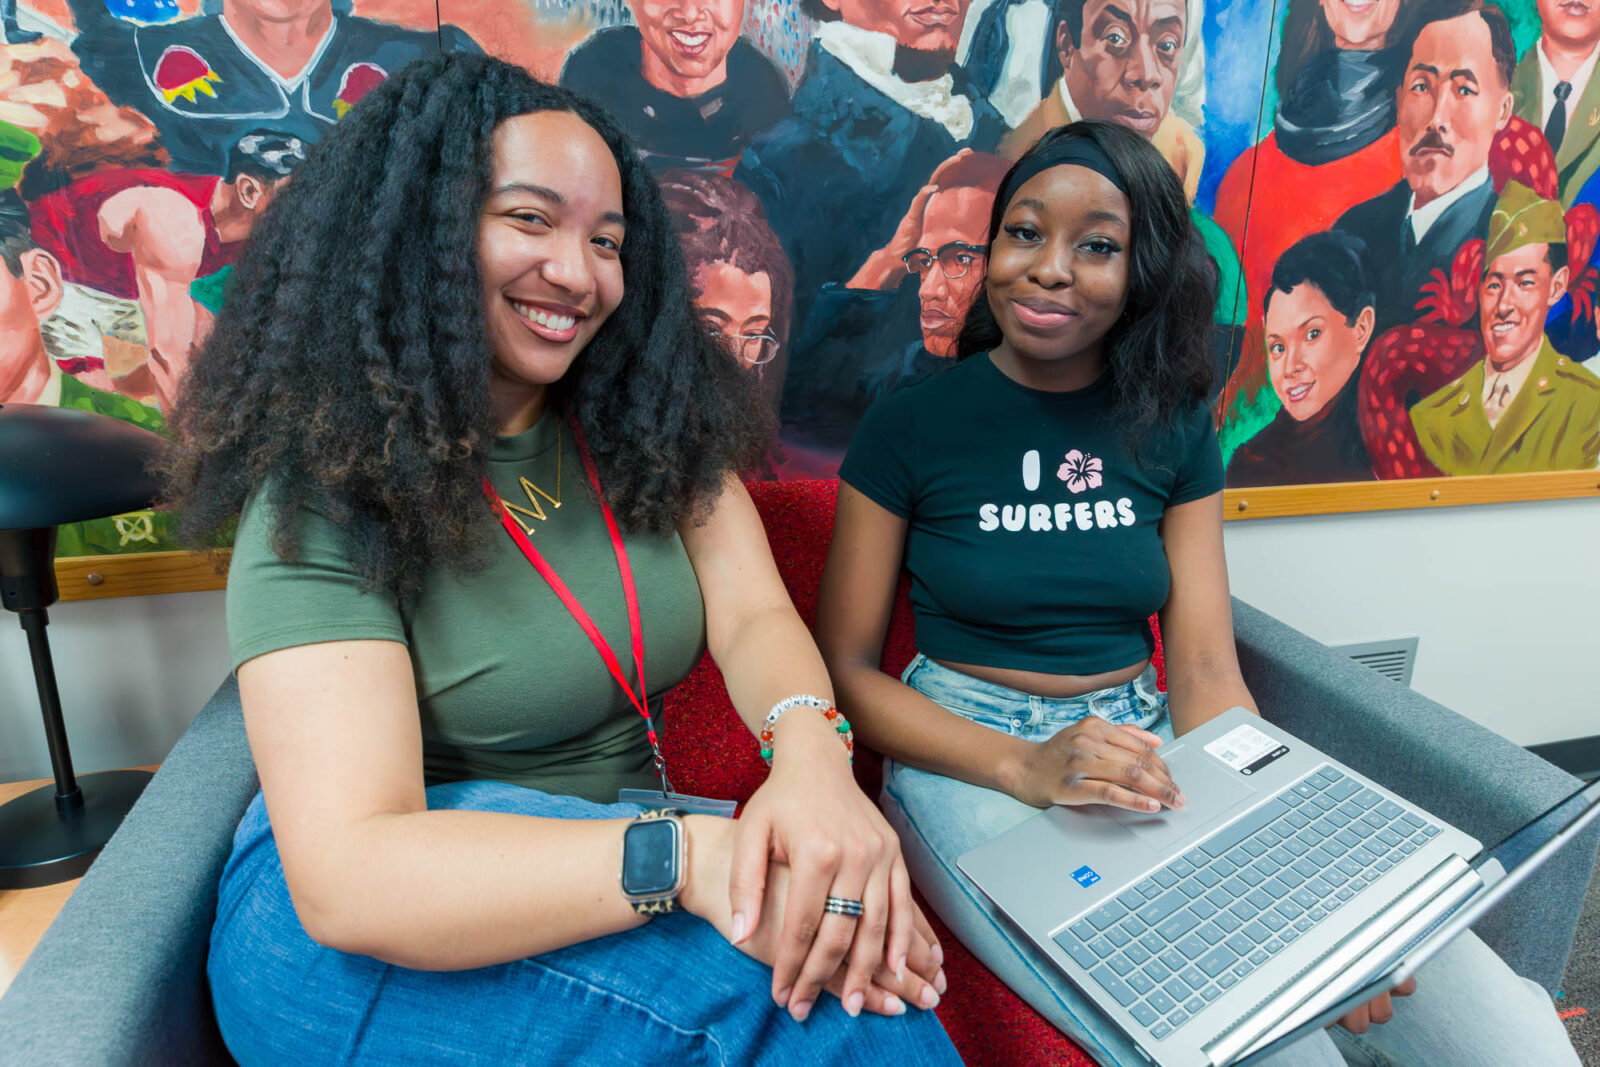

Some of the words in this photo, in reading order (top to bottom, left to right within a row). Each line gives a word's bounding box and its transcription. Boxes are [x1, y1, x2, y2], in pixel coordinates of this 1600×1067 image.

[1022, 449, 1041, 491] I
[501, 476, 562, 536] M
[979, 497, 1136, 532] SURFERS
[777, 699, 809, 714] JUNE
